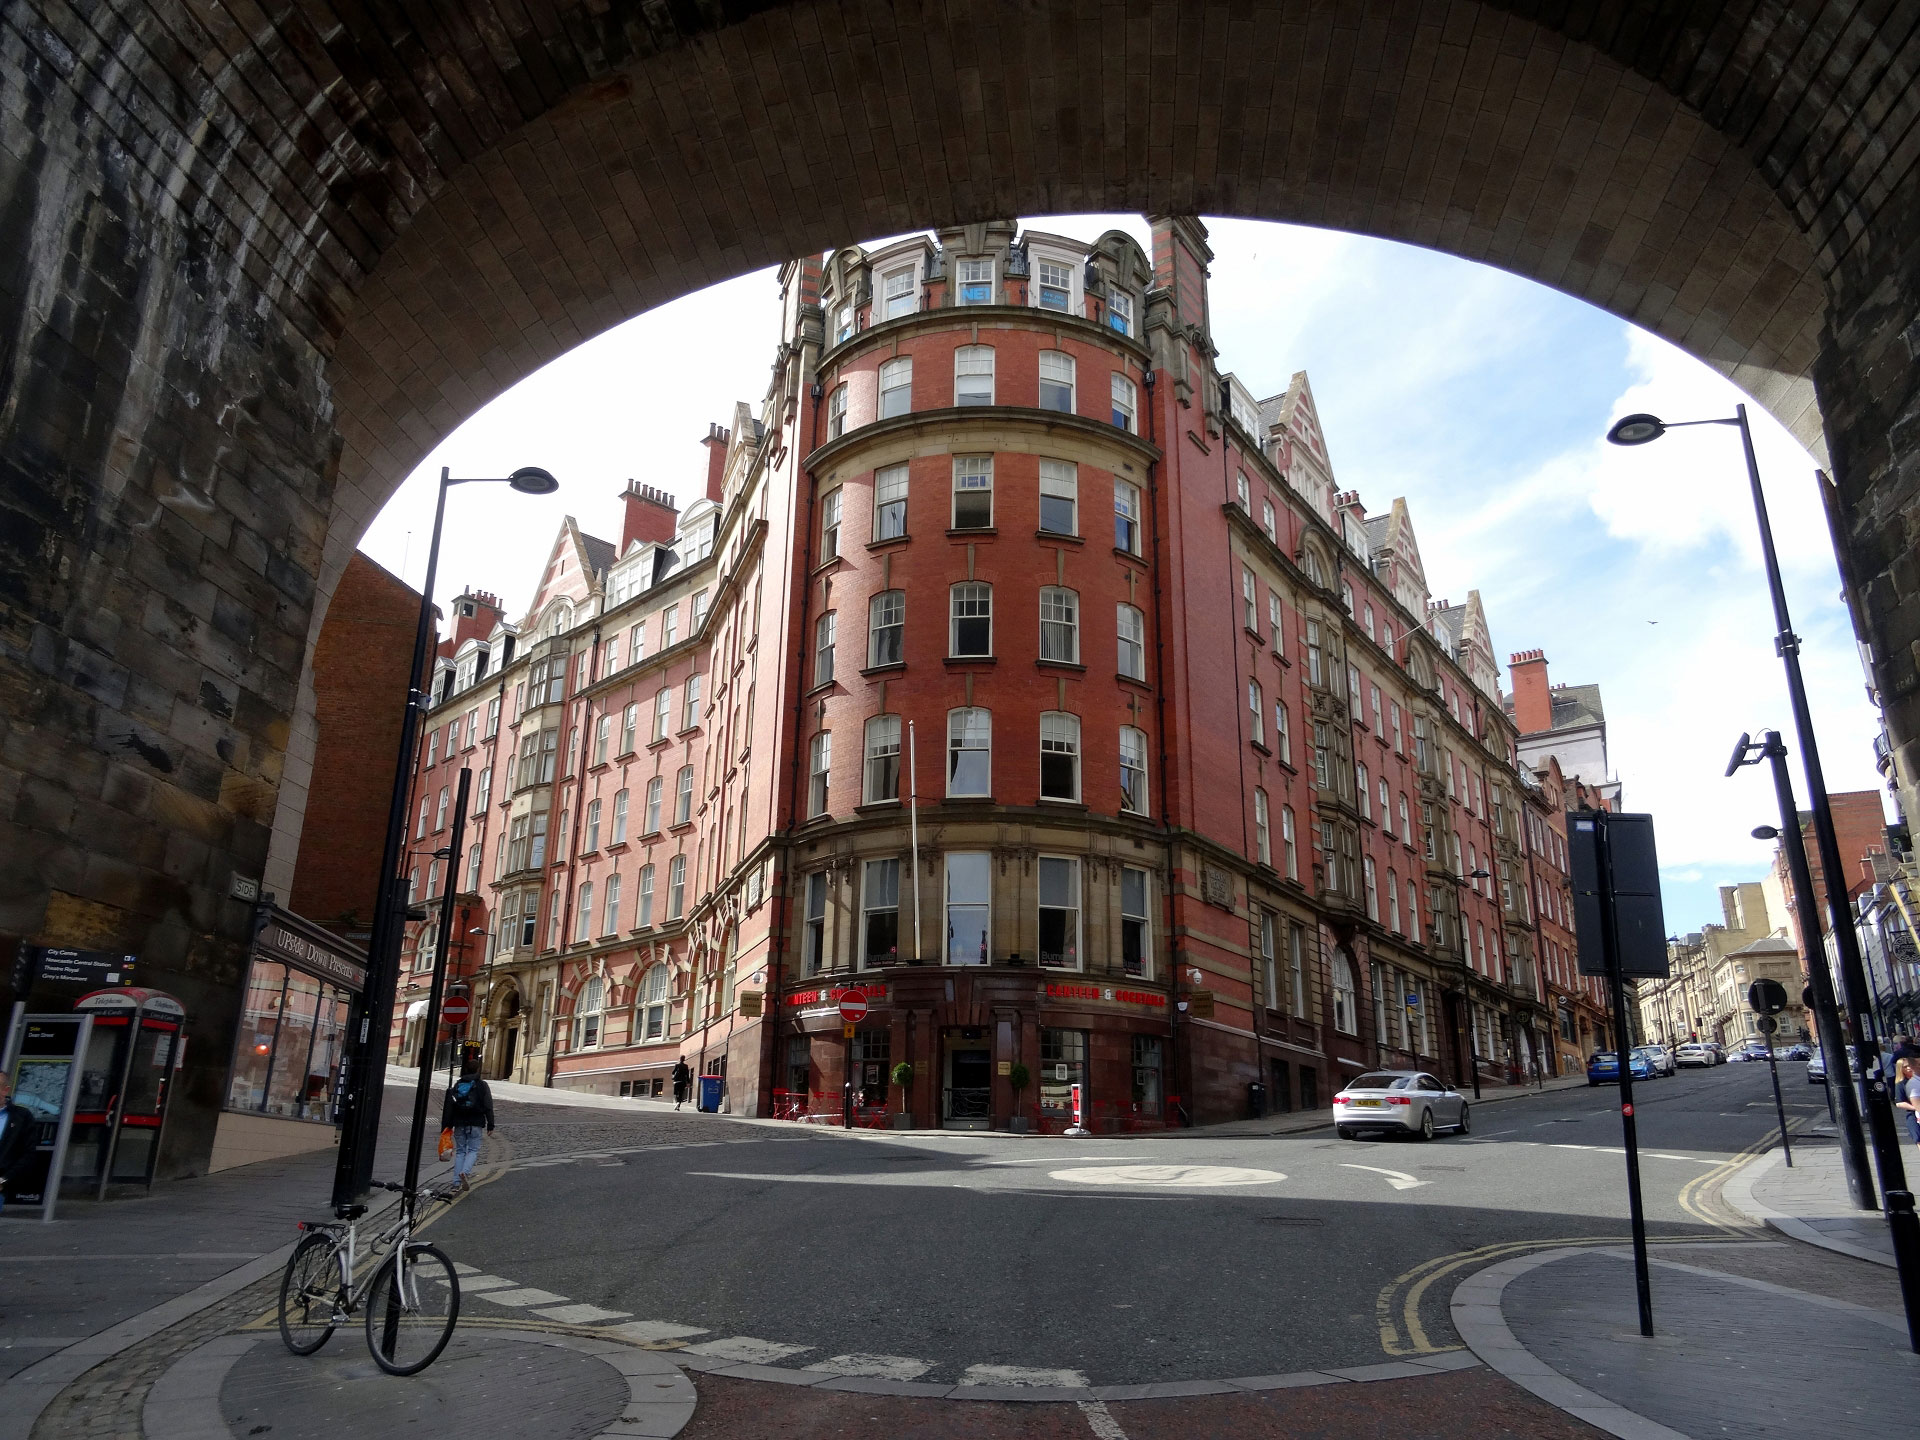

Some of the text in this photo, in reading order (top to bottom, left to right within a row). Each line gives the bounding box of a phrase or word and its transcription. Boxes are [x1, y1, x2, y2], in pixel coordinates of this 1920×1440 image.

[236, 881, 254, 897] SIDE
[45, 957, 73, 965] Newcastle
[306, 943, 328, 967] Down
[328, 954, 353, 979] Presents
[64, 966, 80, 974] Royal
[60, 974, 88, 982] Monument
[1046, 984, 1166, 1007] CANTEEN & COCKTAILS
[464, 1040, 481, 1048] OPEN
